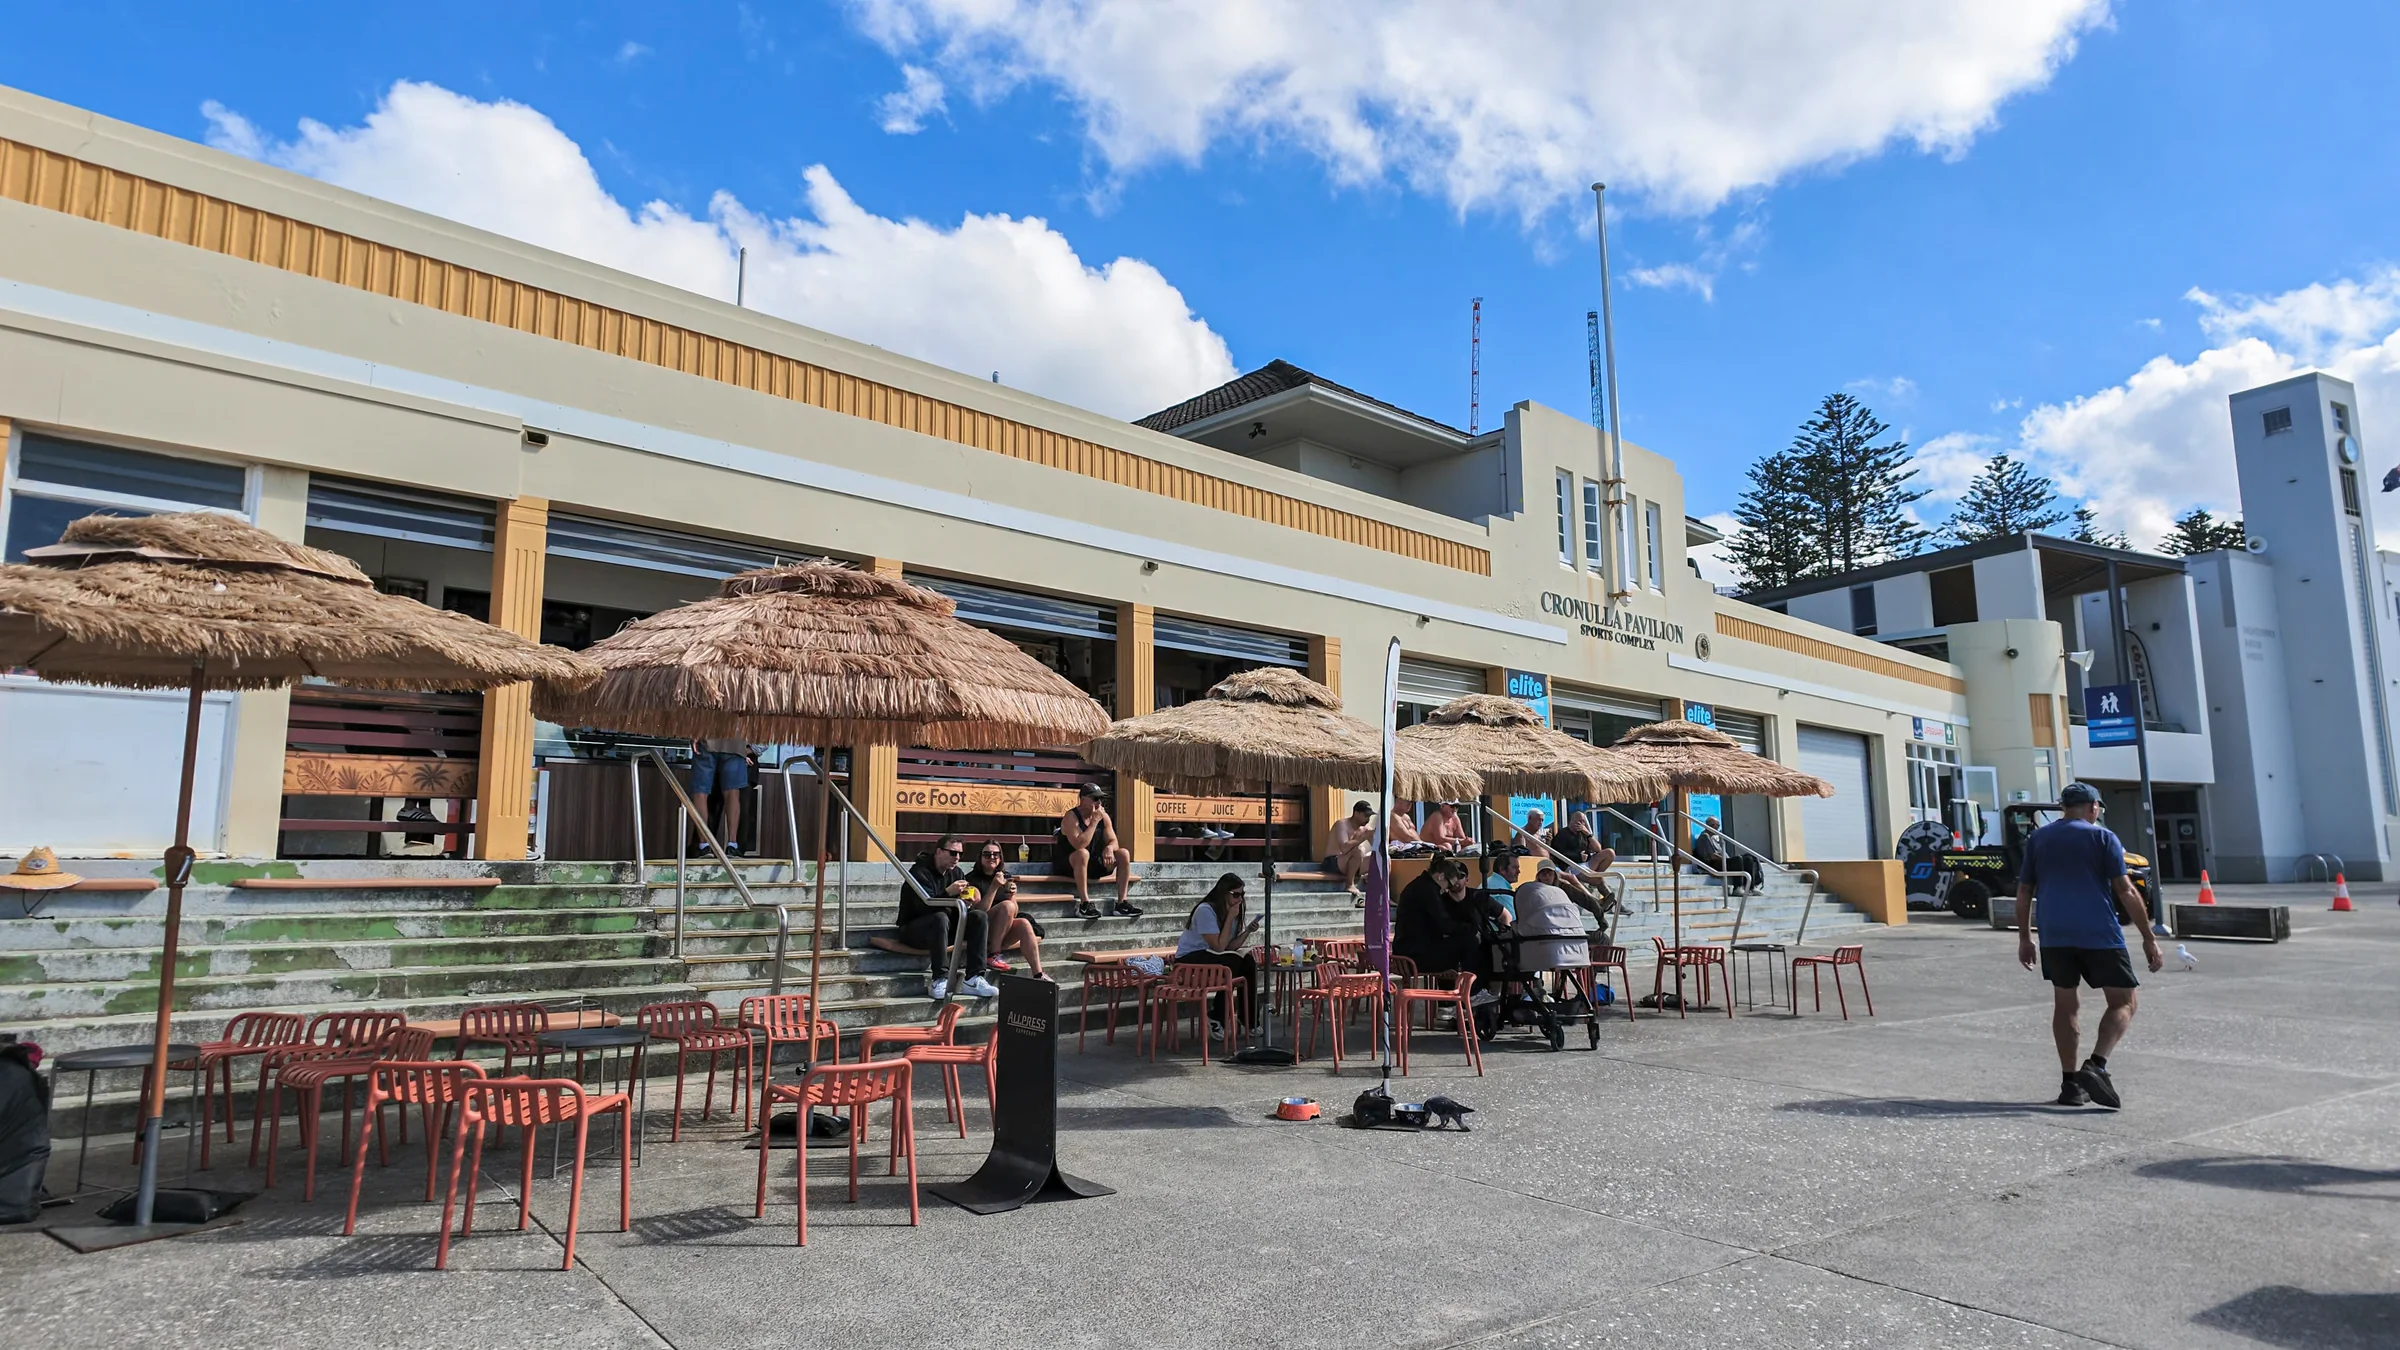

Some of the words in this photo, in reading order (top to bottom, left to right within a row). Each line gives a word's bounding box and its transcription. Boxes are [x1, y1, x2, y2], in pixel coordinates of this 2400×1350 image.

[1541, 591, 1623, 630] CRONULLA
[1625, 612, 1684, 644] PAVILION
[1581, 624, 1613, 641] SPORTS
[1615, 632, 1656, 650] COMPLEX
[1510, 674, 1542, 697] elite
[1687, 704, 1711, 724] elite
[930, 788, 967, 807] Foot
[1156, 802, 1187, 814] COFFEE
[1212, 805, 1234, 816] JUICE
[1007, 1011, 1046, 1030] ALLPRESS
